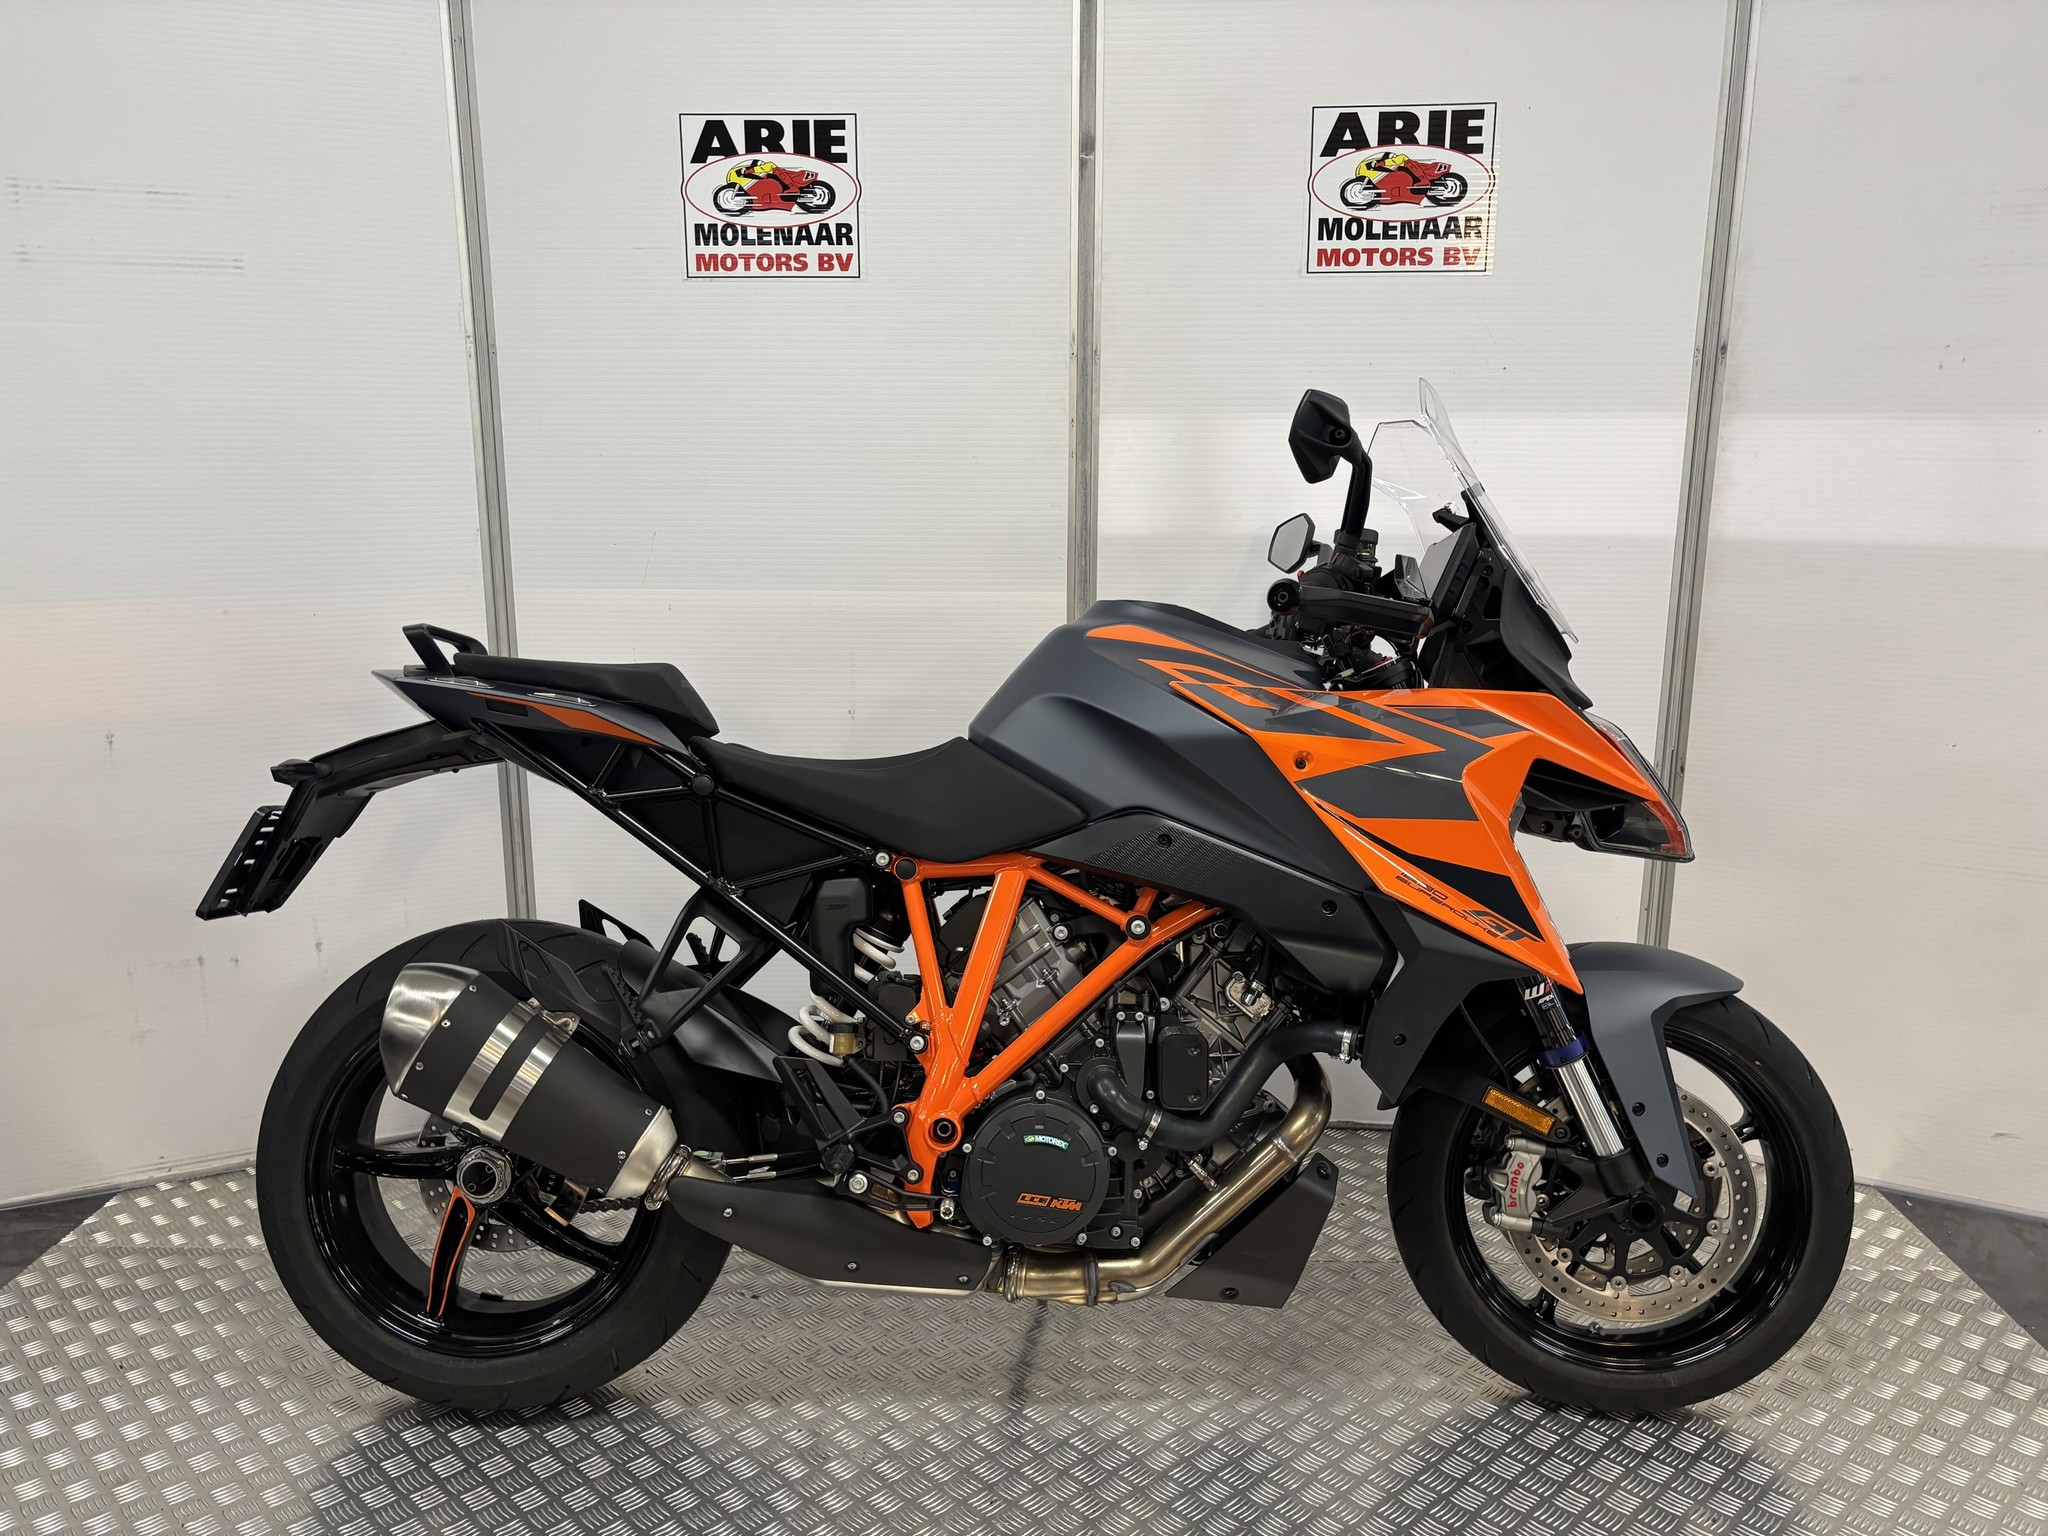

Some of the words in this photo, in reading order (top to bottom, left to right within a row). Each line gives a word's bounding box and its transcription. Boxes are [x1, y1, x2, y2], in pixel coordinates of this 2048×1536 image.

[690, 119, 848, 164] ARIE
[1319, 109, 1485, 157] ARIE
[694, 222, 854, 246] MOLENAAR
[1317, 215, 1482, 241] MOLENAAR
[695, 252, 809, 272] MOTORS
[817, 252, 854, 272] BV
[1316, 247, 1433, 267] MOTORS
[1443, 247, 1481, 266] BV
[1035, 1135, 1067, 1149] MOTOREX
[1507, 1161, 1525, 1209] brembo
[1050, 1198, 1082, 1211] KTM
